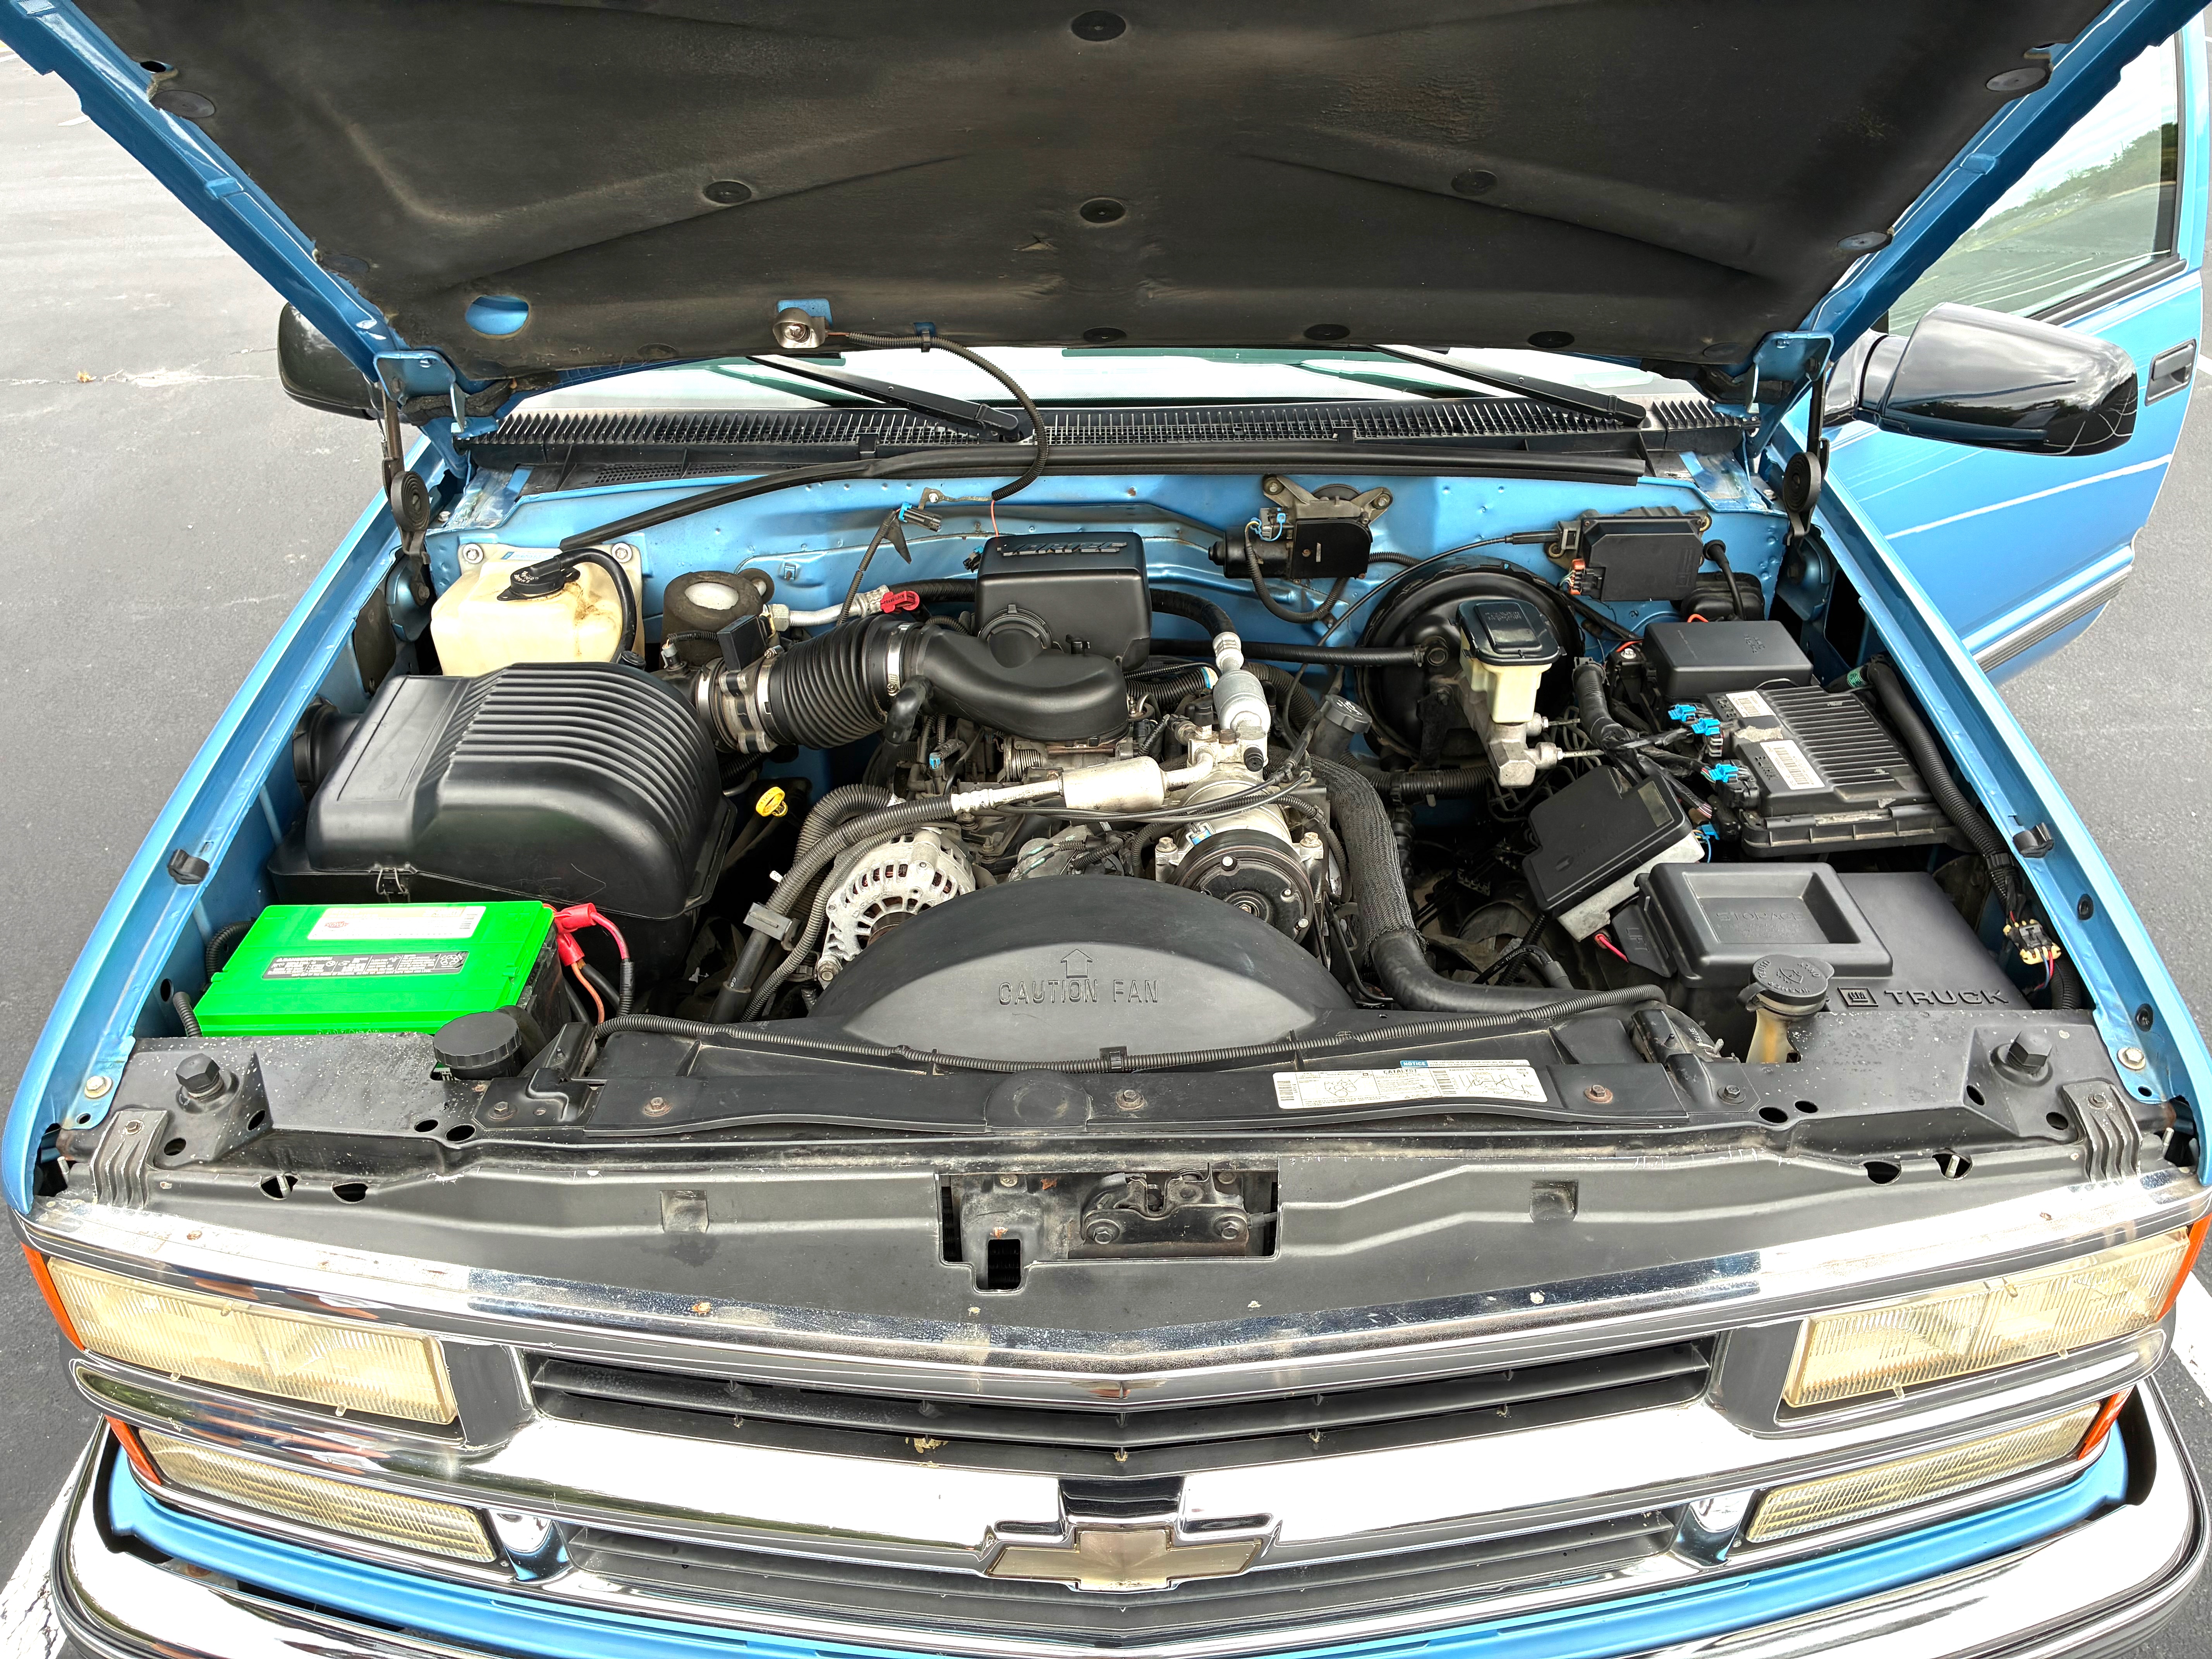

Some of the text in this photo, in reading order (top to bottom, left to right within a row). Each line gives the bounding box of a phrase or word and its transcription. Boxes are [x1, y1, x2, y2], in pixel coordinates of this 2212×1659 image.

[1716, 912, 1808, 921] STORAGE
[1626, 927, 1650, 951] LIFT
[1759, 960, 1771, 978] FLUID
[999, 979, 1158, 1005] CAUTION FAN
[1847, 990, 2009, 1005] GM TRUCK
